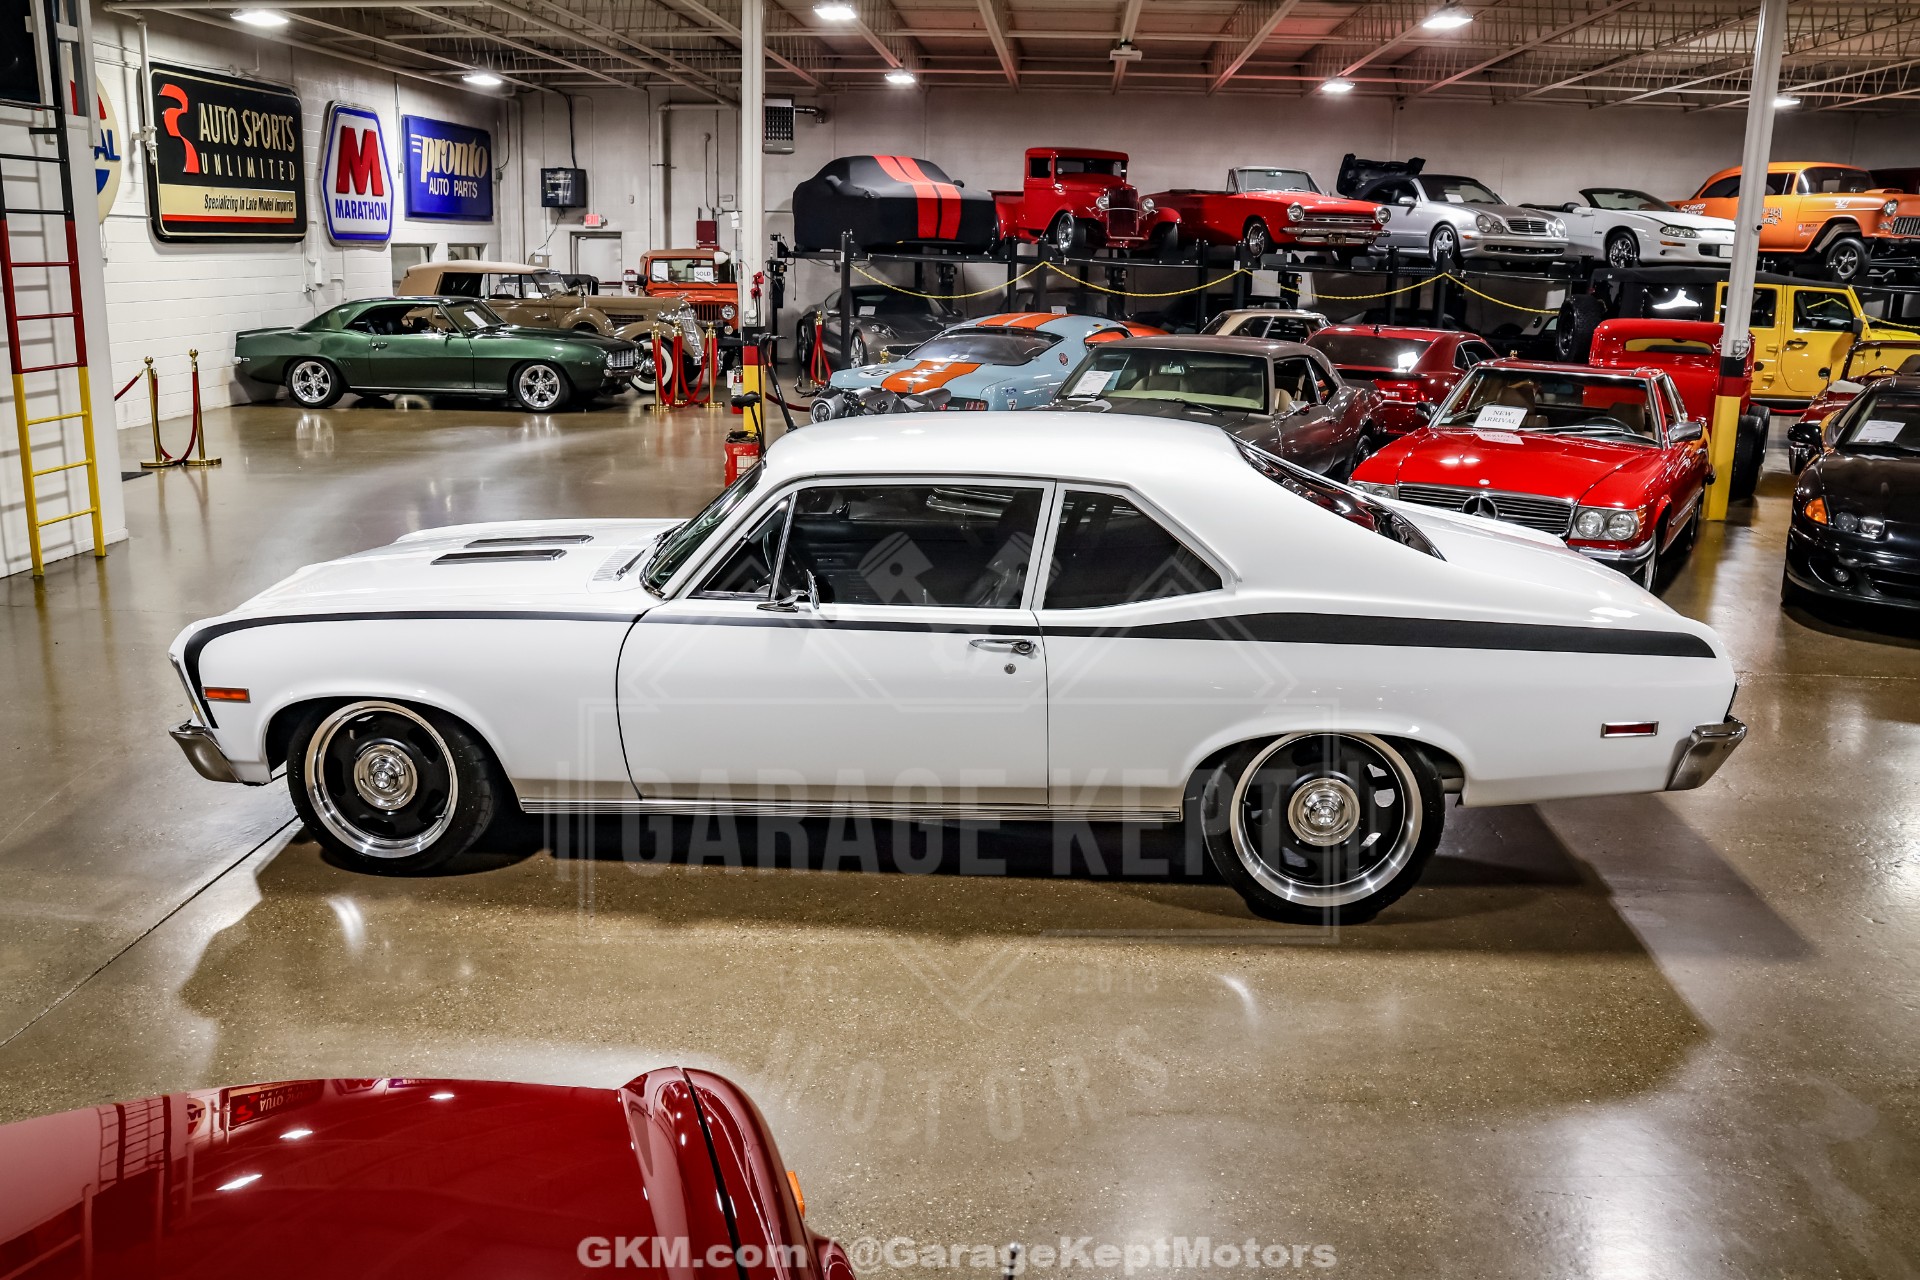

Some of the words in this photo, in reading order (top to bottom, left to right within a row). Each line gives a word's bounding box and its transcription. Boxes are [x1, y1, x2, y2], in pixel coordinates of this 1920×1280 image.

[198, 102, 239, 146] AUTO
[242, 109, 295, 152] SPORTS
[200, 152, 295, 182] UNLIMITED
[420, 136, 488, 183] pronto
[429, 177, 450, 197] AUTO
[453, 180, 478, 199] PARTS
[204, 193, 238, 212] Specializing
[246, 196, 257, 211] Late
[258, 195, 274, 212] Model
[275, 196, 294, 213] Imports
[335, 198, 388, 221] MARATHON
[1481, 416, 1517, 425] ARRIVAL
